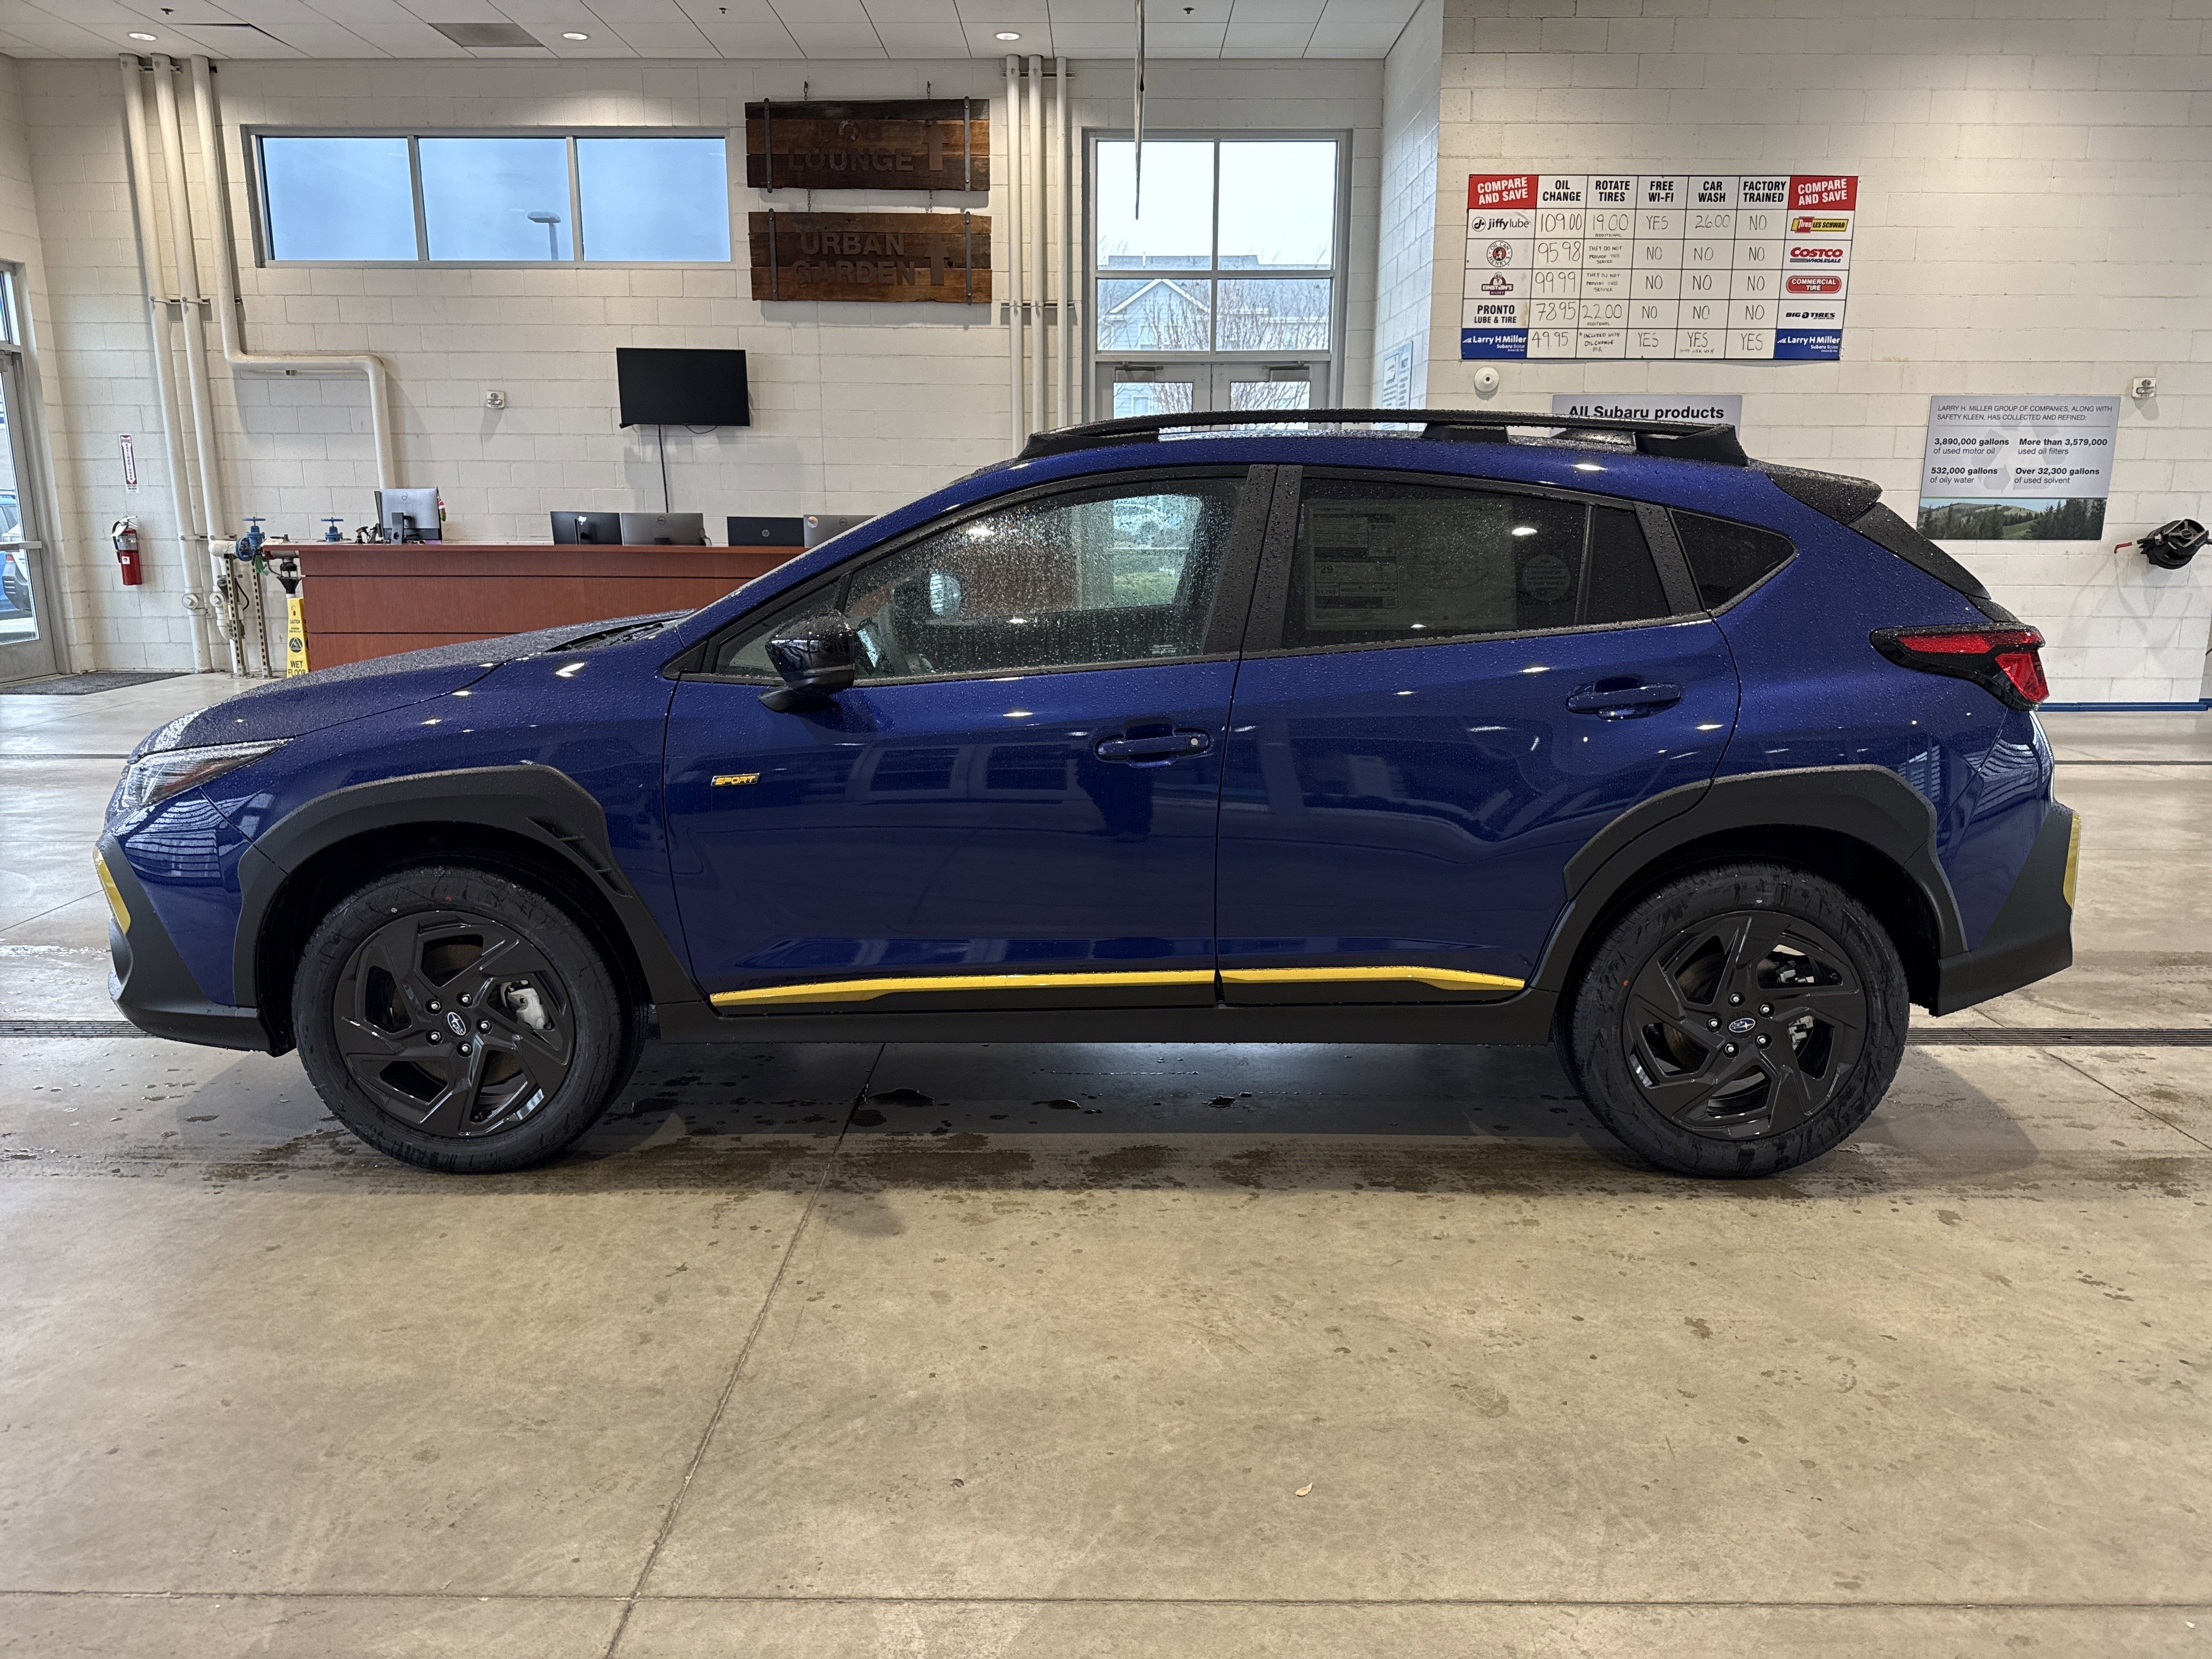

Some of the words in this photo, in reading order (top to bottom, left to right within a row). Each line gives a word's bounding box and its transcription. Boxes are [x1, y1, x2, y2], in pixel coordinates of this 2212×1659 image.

[788, 148, 913, 172] LOUNGE
[1477, 177, 1528, 193] COMPARE
[1555, 180, 1570, 190] OIL
[1595, 180, 1630, 190] ROTATE
[1650, 181, 1674, 190] FREE
[1703, 181, 1722, 190] CAR
[1743, 181, 1786, 191] FACTORY
[1798, 178, 1847, 195] COMPARE
[1479, 193, 1499, 205] AND
[1502, 188, 1528, 201] SAVE
[1543, 191, 1581, 201] CHANGE
[1599, 192, 1625, 201] TIRES
[1649, 192, 1674, 202] WI-FI
[1699, 193, 1726, 202] WASH
[1743, 193, 1784, 202] TRAINED
[1798, 194, 1819, 206] AND
[1822, 190, 1848, 203] SAVE
[1646, 215, 1668, 230] YES
[1749, 215, 1767, 230] NO
[1798, 219, 1812, 229] Tires
[800, 232, 905, 256] URBAN
[1499, 241, 1510, 250] CAN
[1646, 246, 1662, 260] NO
[1694, 247, 1714, 261] NO
[1749, 246, 1765, 261] NO
[1790, 247, 1843, 258] COSTCO
[1488, 256, 1510, 266] HENRY'S
[792, 260, 916, 286] GARDEN
[1646, 275, 1663, 290] NO
[1692, 274, 1712, 290] NO
[1747, 275, 1765, 291] NO
[1477, 304, 1515, 314] PRONTO
[1642, 306, 1657, 319] NO
[1693, 305, 1709, 320] NO
[1745, 304, 1764, 320] NO
[1473, 336, 1494, 345] Larry
[1638, 332, 1659, 347] YES
[1688, 331, 1708, 348] YES
[1741, 333, 1763, 351] YES
[1787, 336, 1809, 345] Larry
[1569, 406, 1588, 416] All
[1593, 405, 1649, 418] Subaru
[1655, 406, 1724, 420] products
[1934, 438, 1977, 446] 3,890,000
[1979, 438, 2009, 447] gallons
[1967, 467, 1998, 476] gallons
[2069, 468, 2100, 476] gallons
[1938, 476, 1952, 485] oily
[715, 775, 756, 785] SPORT
